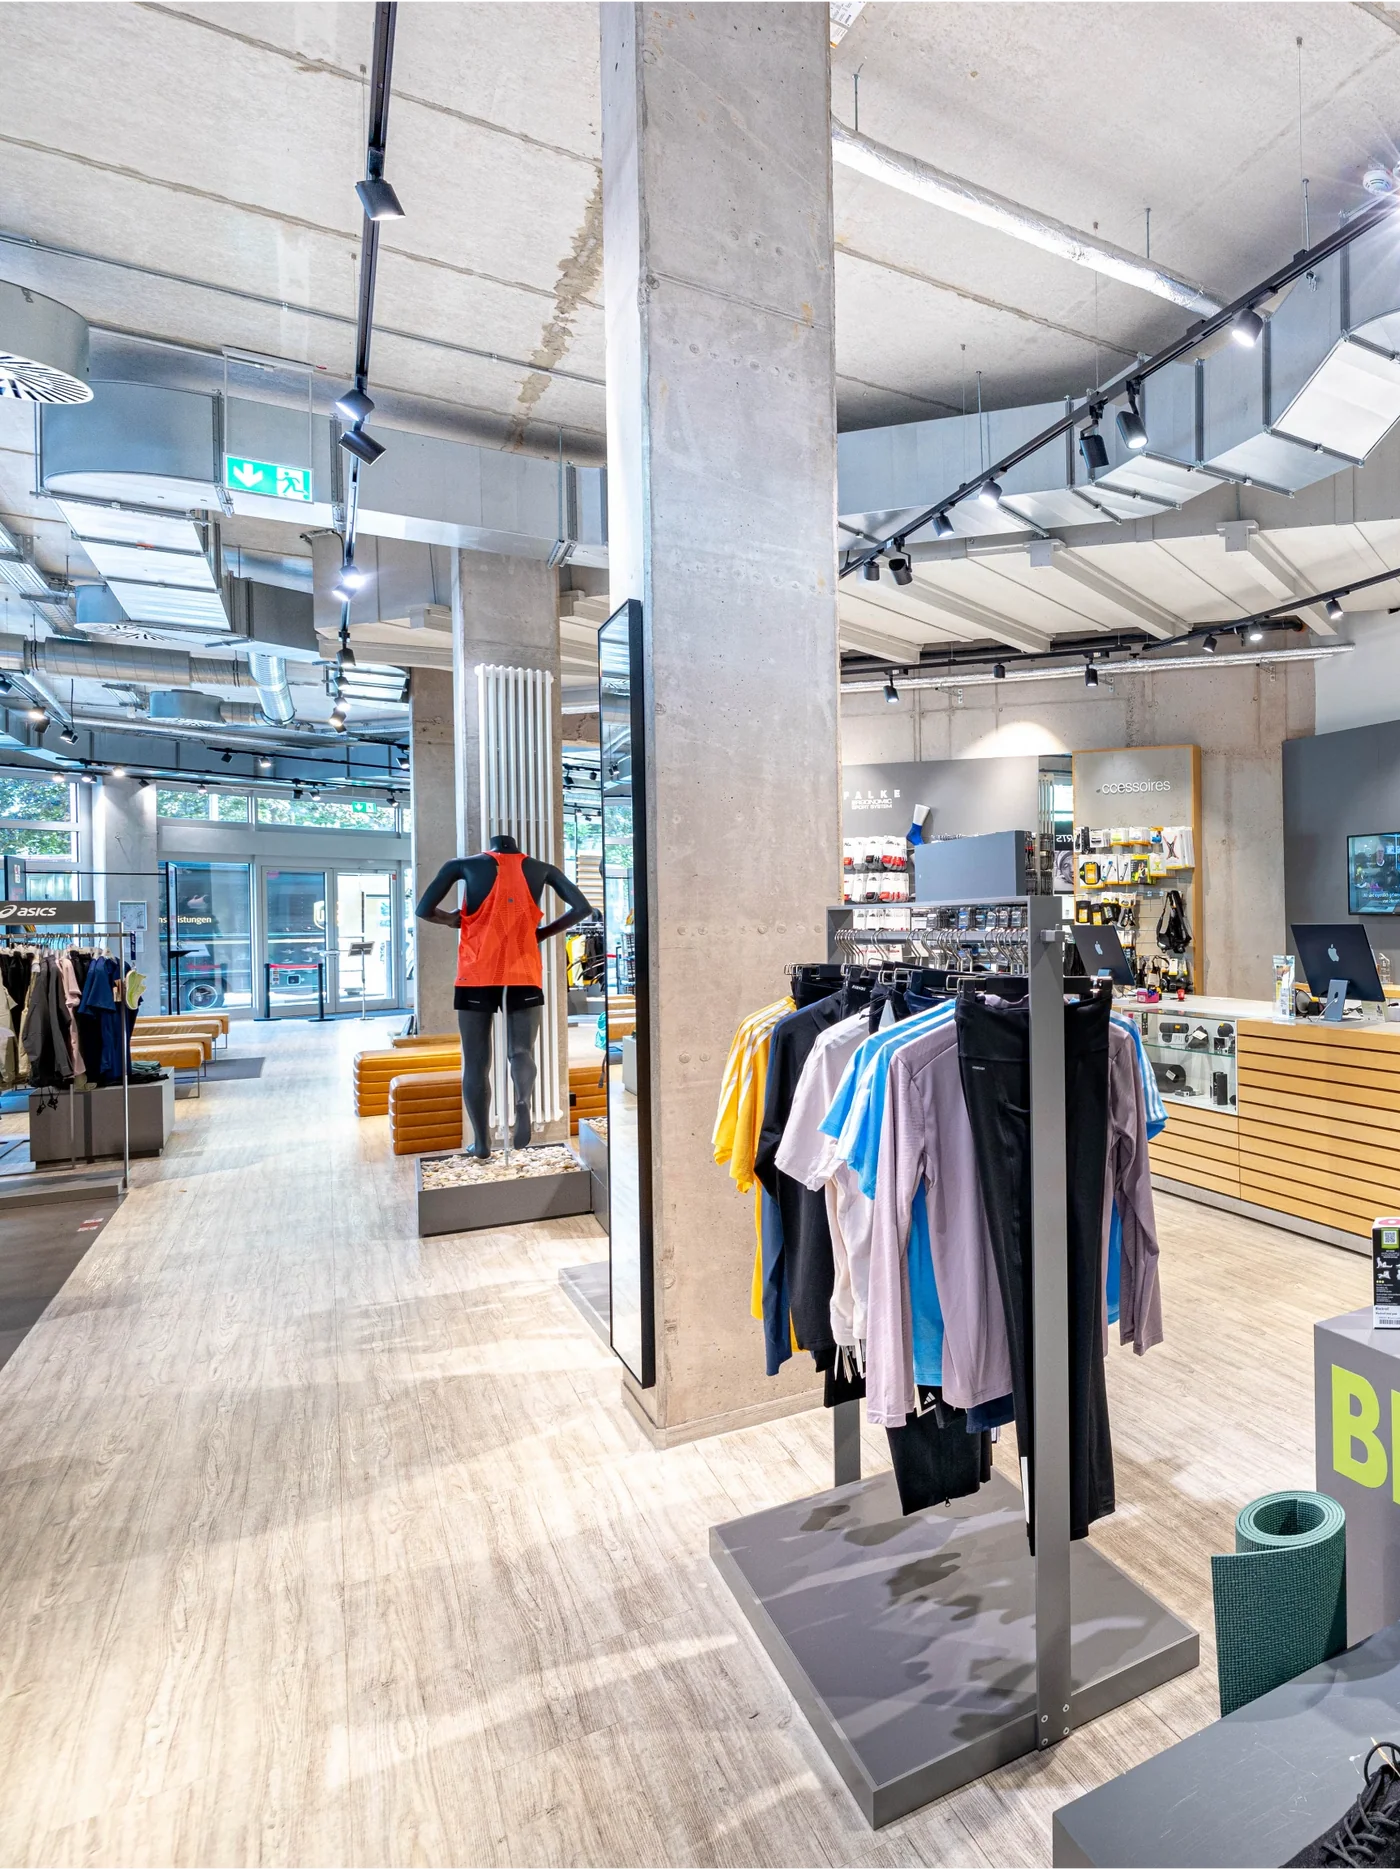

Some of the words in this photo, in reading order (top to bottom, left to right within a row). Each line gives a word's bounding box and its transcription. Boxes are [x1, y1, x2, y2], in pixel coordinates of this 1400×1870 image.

[1102, 779, 1171, 794] ccessoires
[843, 789, 901, 800] FALKE
[17, 907, 57, 917] asics
